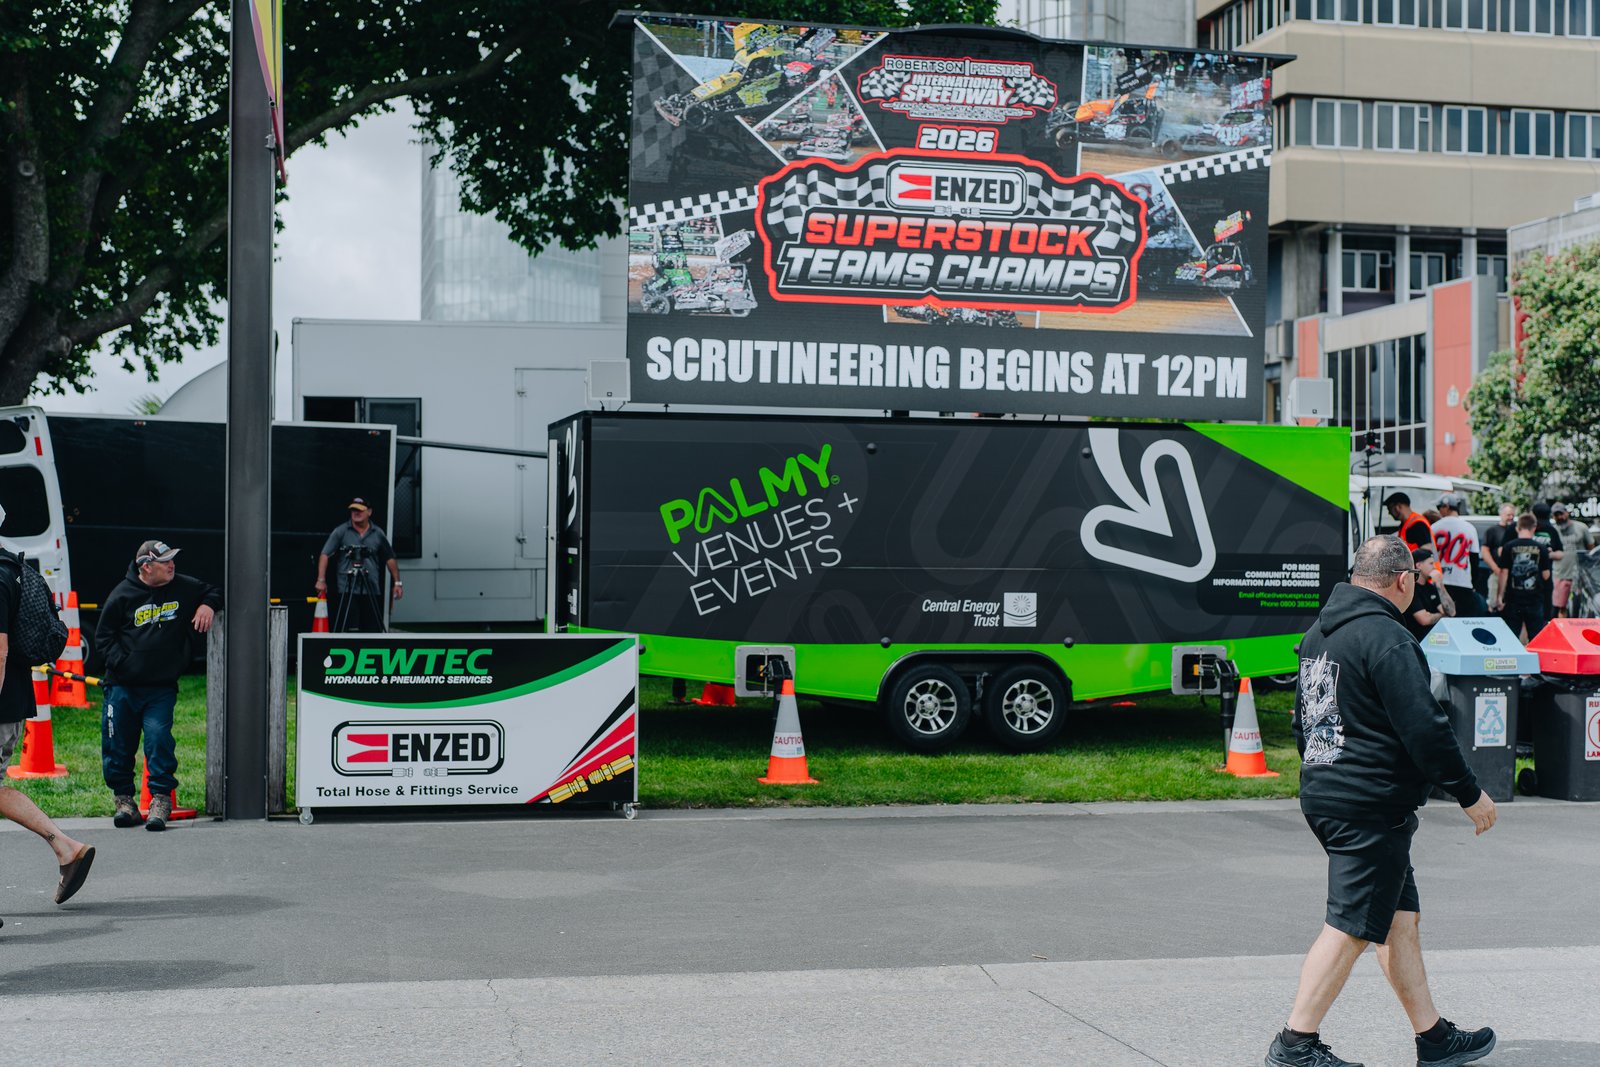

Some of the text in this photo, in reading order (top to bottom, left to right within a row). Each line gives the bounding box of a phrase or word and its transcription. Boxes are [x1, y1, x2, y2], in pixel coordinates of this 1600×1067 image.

[886, 59, 1031, 77] ROBERTSON PRESTIGE
[911, 74, 1004, 90] INTERNATIONAL
[901, 84, 1014, 106] SPEEDWAY
[918, 127, 995, 152] 2026
[934, 175, 1016, 205] ENZED
[805, 212, 1098, 257] SUPERSTOCK
[783, 248, 935, 288] TEAMS
[936, 253, 1121, 296] CHAMPS
[646, 336, 1248, 399] SCRUTINEERING BEGINS AT 12PM
[659, 443, 832, 544] PALMY
[672, 497, 831, 578] VENUES
[690, 534, 842, 616] EVENTS
[1282, 563, 1320, 571] FOR MORE
[1291, 571, 1320, 579] SCREEN
[1213, 579, 1320, 587] INFORMATION AND BOOKINGS
[1238, 591, 1255, 599] Email
[922, 599, 1000, 615] Central Energy
[1260, 600, 1279, 608] Phone
[973, 614, 1001, 627] Trust
[324, 648, 493, 675] DEWTEC
[324, 675, 493, 684] HYDRAULIC & PNEUMATIC SERVICES
[774, 735, 803, 745] CAUTIO
[1233, 730, 1262, 741] CAUTIO
[392, 732, 491, 762] ENZED
[316, 783, 519, 798] Total Hose & Fittings Service
